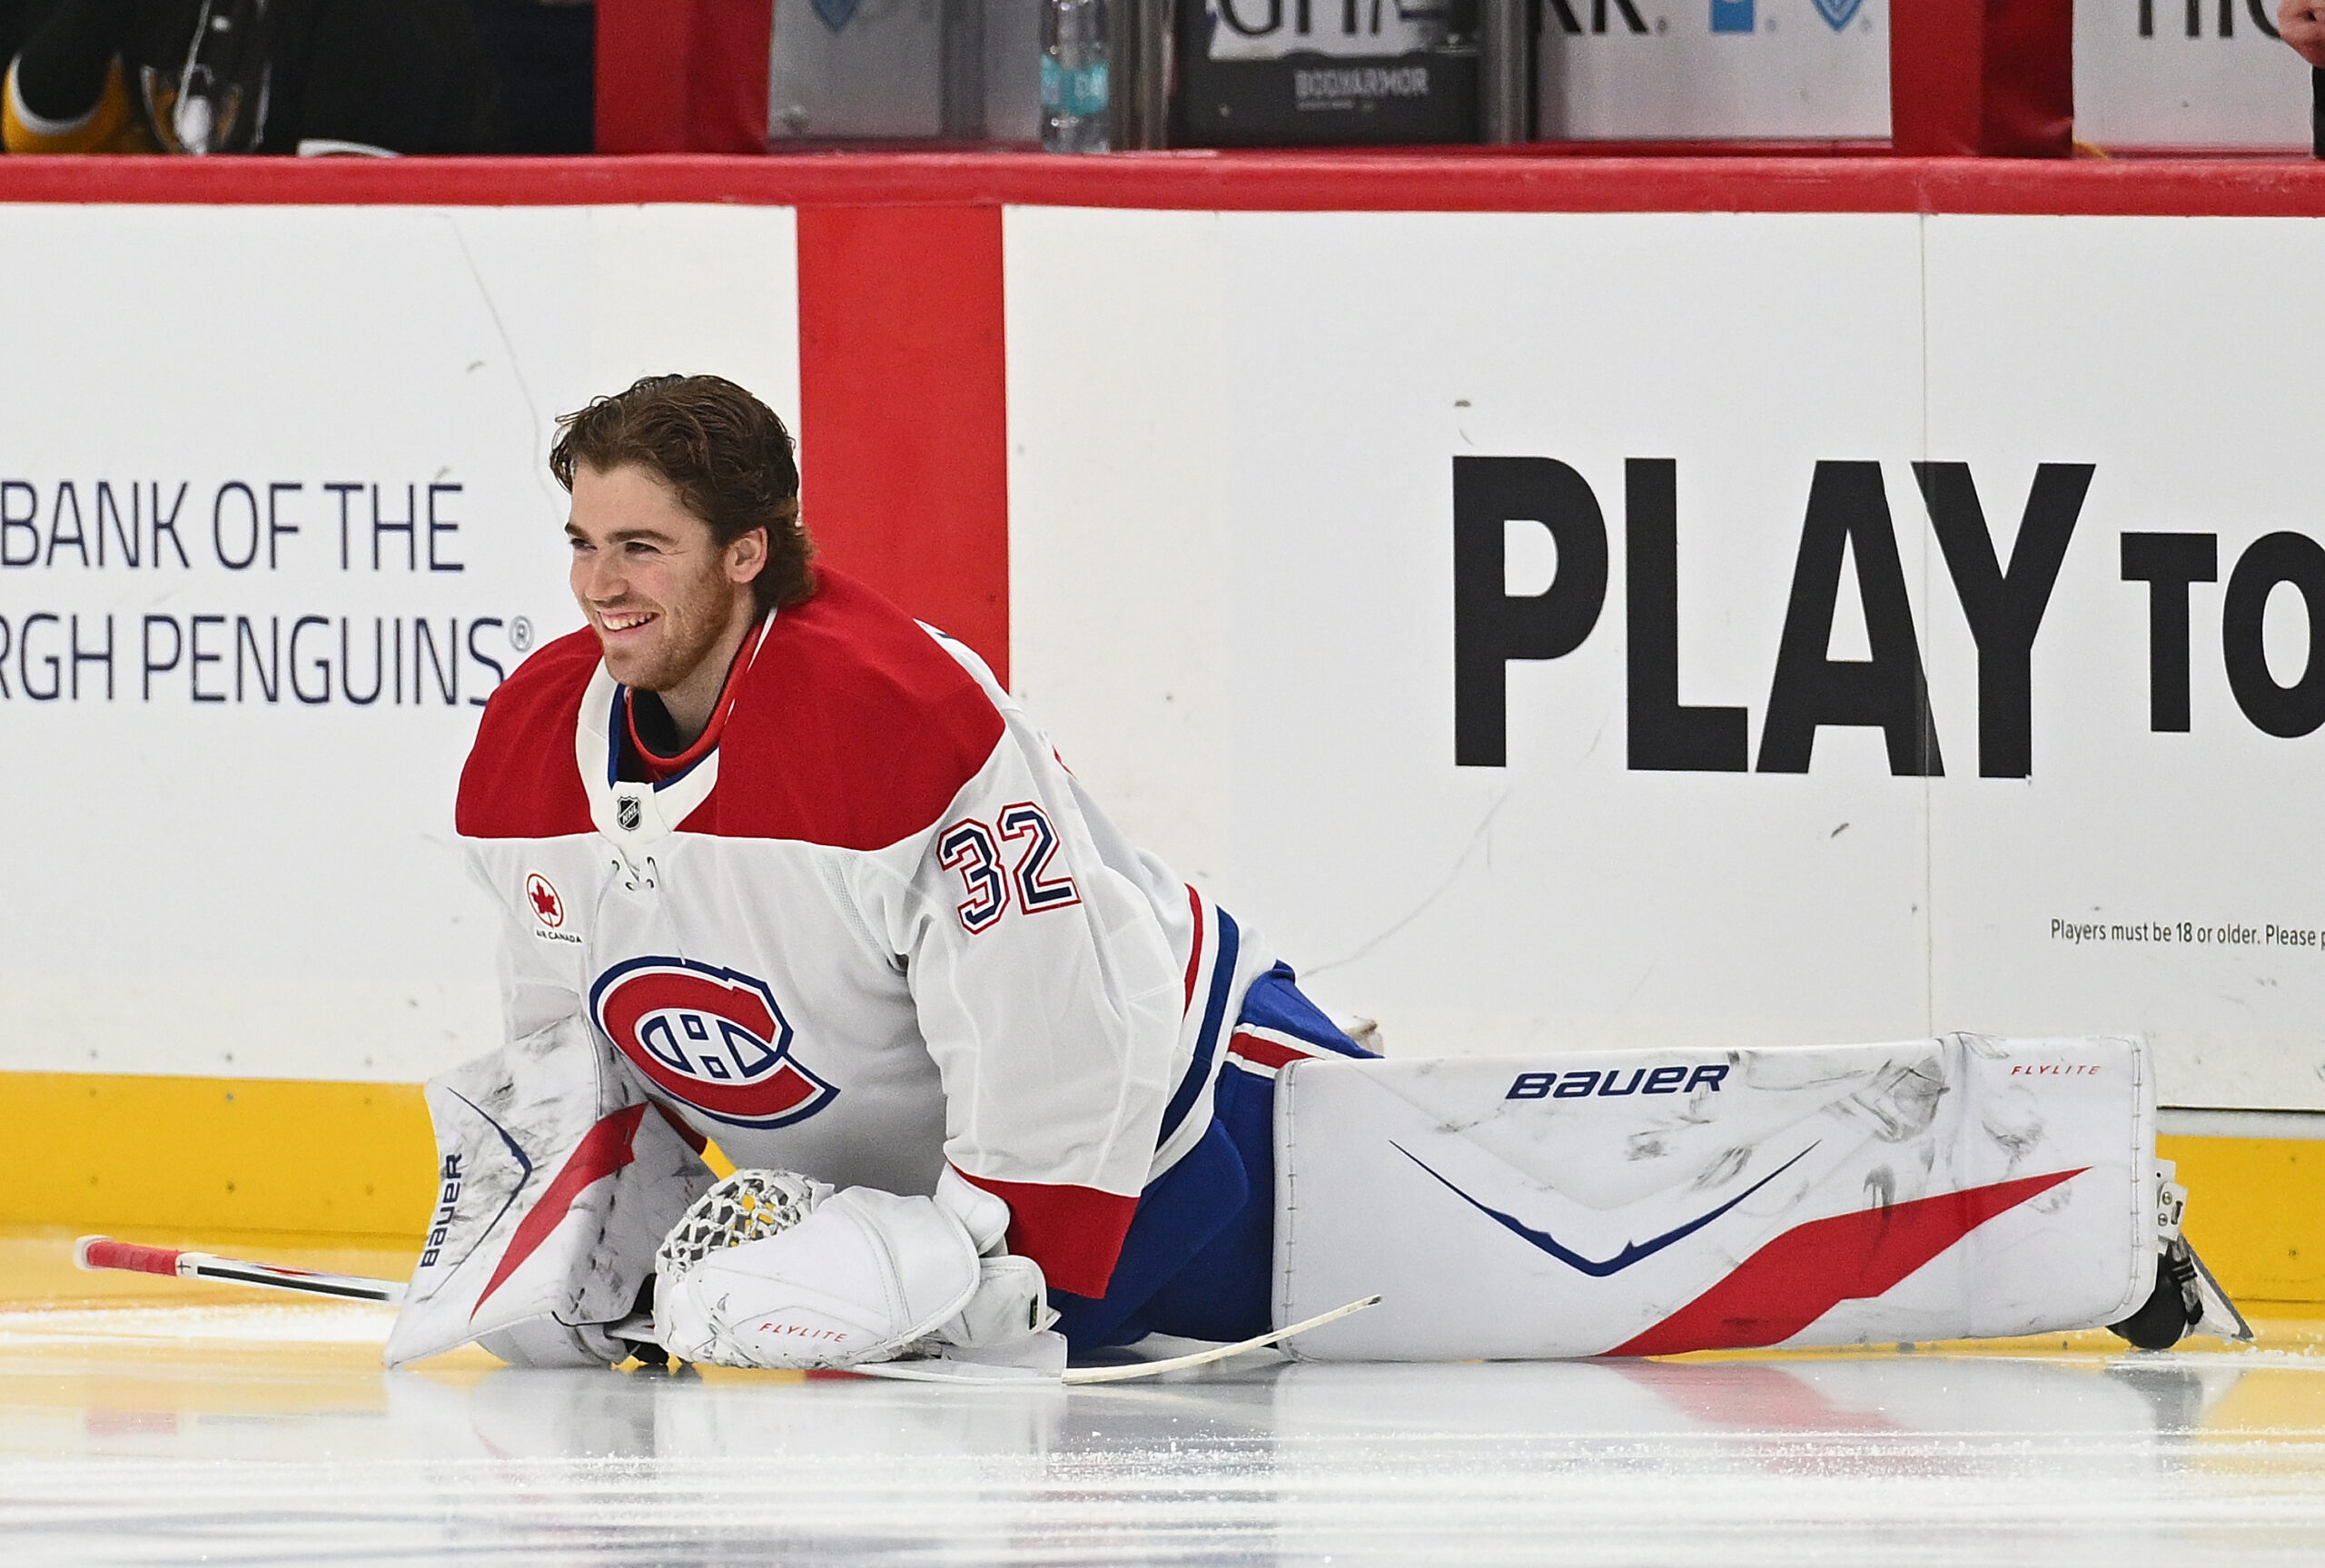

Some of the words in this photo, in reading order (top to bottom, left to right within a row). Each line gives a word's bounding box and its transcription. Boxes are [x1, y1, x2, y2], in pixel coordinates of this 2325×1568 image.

[1, 481, 191, 567] BANK
[213, 481, 303, 570] OF
[323, 483, 465, 572] THE
[1453, 455, 2096, 779] PLAY
[2120, 530, 2325, 738] TO
[936, 801, 1082, 935] 32
[548, 931, 583, 944] CANADA
[2051, 919, 2107, 945] Players
[2112, 922, 2149, 942] must
[2153, 922, 2172, 942] be
[2176, 922, 2193, 942] 18
[2197, 927, 2213, 943] or
[2217, 923, 2261, 945] older.
[2266, 924, 2316, 946] Please
[1505, 1063, 1730, 1101] BAUER
[2010, 1065, 2101, 1075] FLYLITE
[420, 1153, 462, 1267] BAUER
[758, 1322, 847, 1343] FLYLITE
